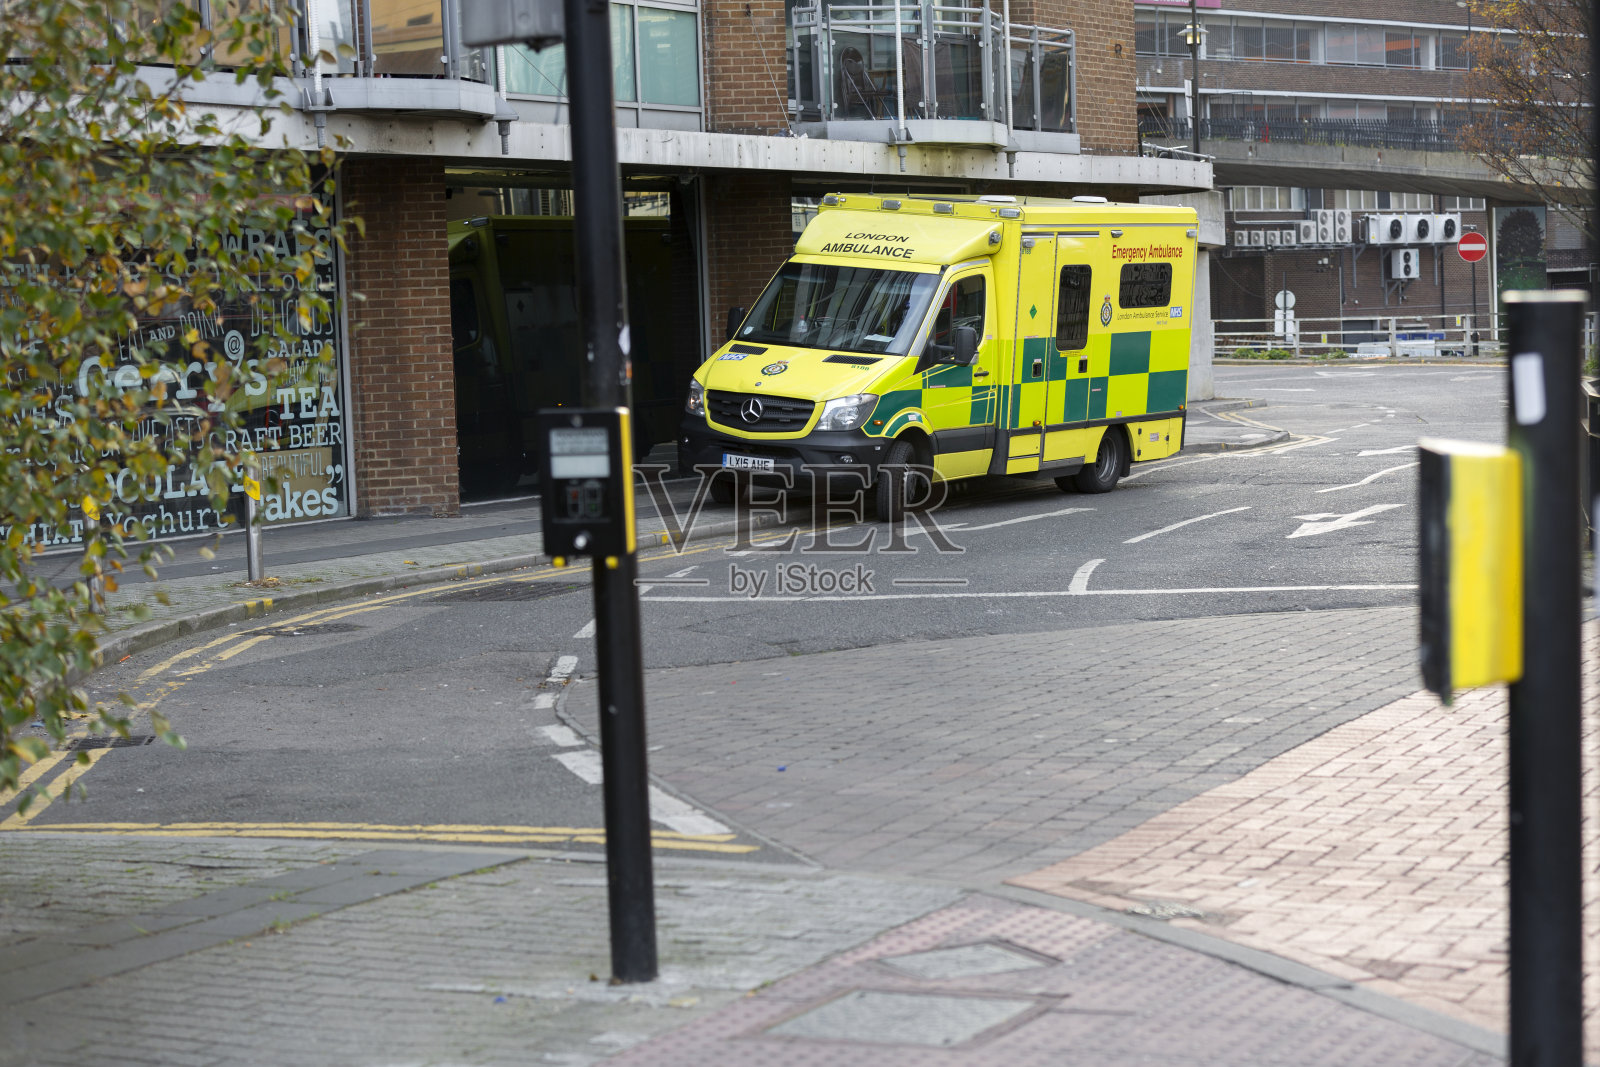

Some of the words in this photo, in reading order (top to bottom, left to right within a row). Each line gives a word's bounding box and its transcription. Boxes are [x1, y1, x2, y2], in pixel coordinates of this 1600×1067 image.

[845, 232, 909, 243] LONDON
[821, 243, 914, 259] AMBULANCE
[1112, 244, 1147, 262] Emergency
[1148, 244, 1183, 259] Ambulance
[1133, 311, 1154, 319] Ambulance
[1155, 310, 1168, 318] Service
[1170, 307, 1182, 317] NHS
[149, 325, 176, 341] AND
[717, 353, 748, 361] NHS
[276, 386, 340, 420] TEA
[209, 426, 282, 454] CRAFT
[288, 422, 343, 449] BEER
[729, 456, 749, 470] LX15
[750, 459, 770, 471] AHE
[260, 481, 339, 521] akes
